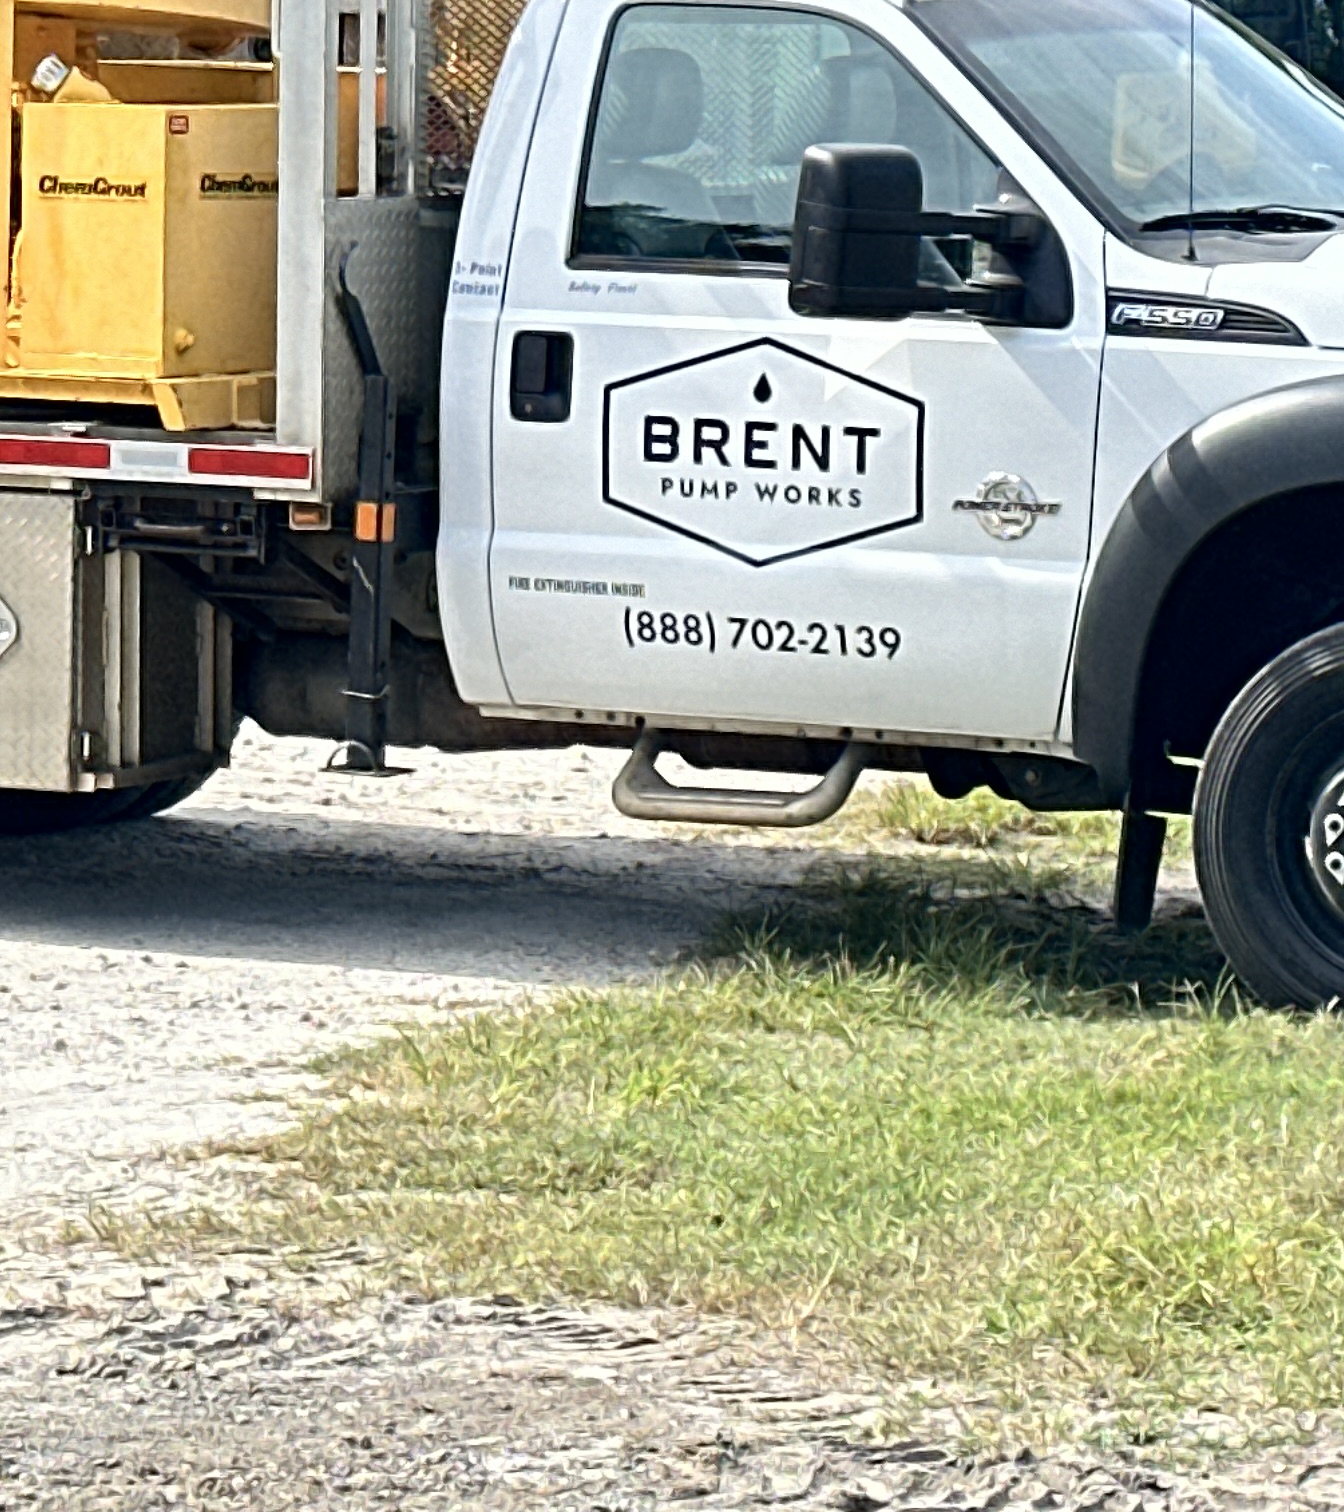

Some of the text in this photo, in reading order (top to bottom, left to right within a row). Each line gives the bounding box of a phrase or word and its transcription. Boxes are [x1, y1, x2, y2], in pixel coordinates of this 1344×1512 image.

[39, 175, 147, 198] ChemGrout
[201, 173, 279, 192] ChemGrou
[644, 415, 881, 475] BRENT
[660, 477, 862, 508] PUMP WORKS
[624, 606, 902, 660] (888) 702-2139
